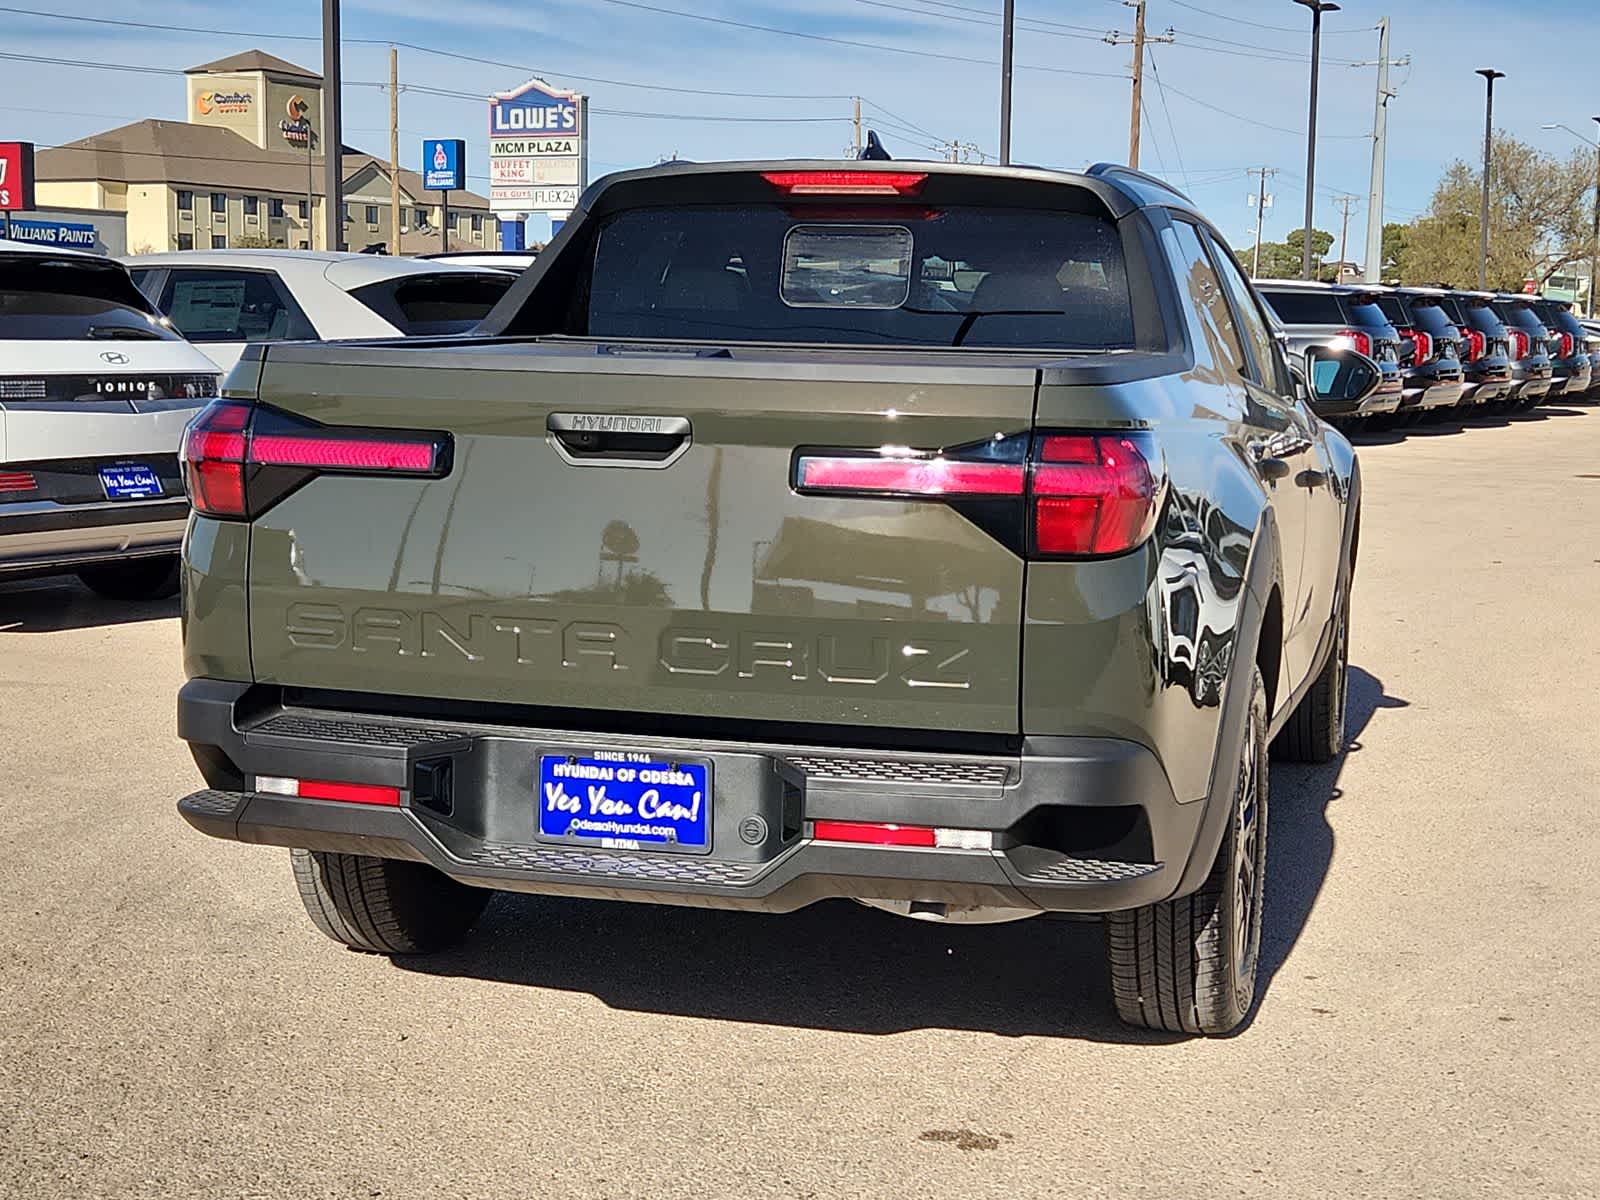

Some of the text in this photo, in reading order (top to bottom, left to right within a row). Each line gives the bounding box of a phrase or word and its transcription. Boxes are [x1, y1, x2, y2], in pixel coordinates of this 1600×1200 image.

[496, 103, 576, 130] LOWE'S
[495, 141, 572, 154] MCM PLAZA
[493, 160, 530, 169] BUFFET
[500, 169, 525, 178] KING
[491, 190, 532, 198] FIVE GUYS
[58, 227, 96, 244] PAINTS
[572, 415, 662, 432] HYUNDAI
[286, 602, 971, 689] SANTA CRUZ
[593, 751, 625, 762] SINCE
[553, 764, 695, 786] HYUNDAI OF ODESSA
[544, 782, 701, 823] Yes You Can!
[570, 817, 676, 836] OdessaHyundai.com
